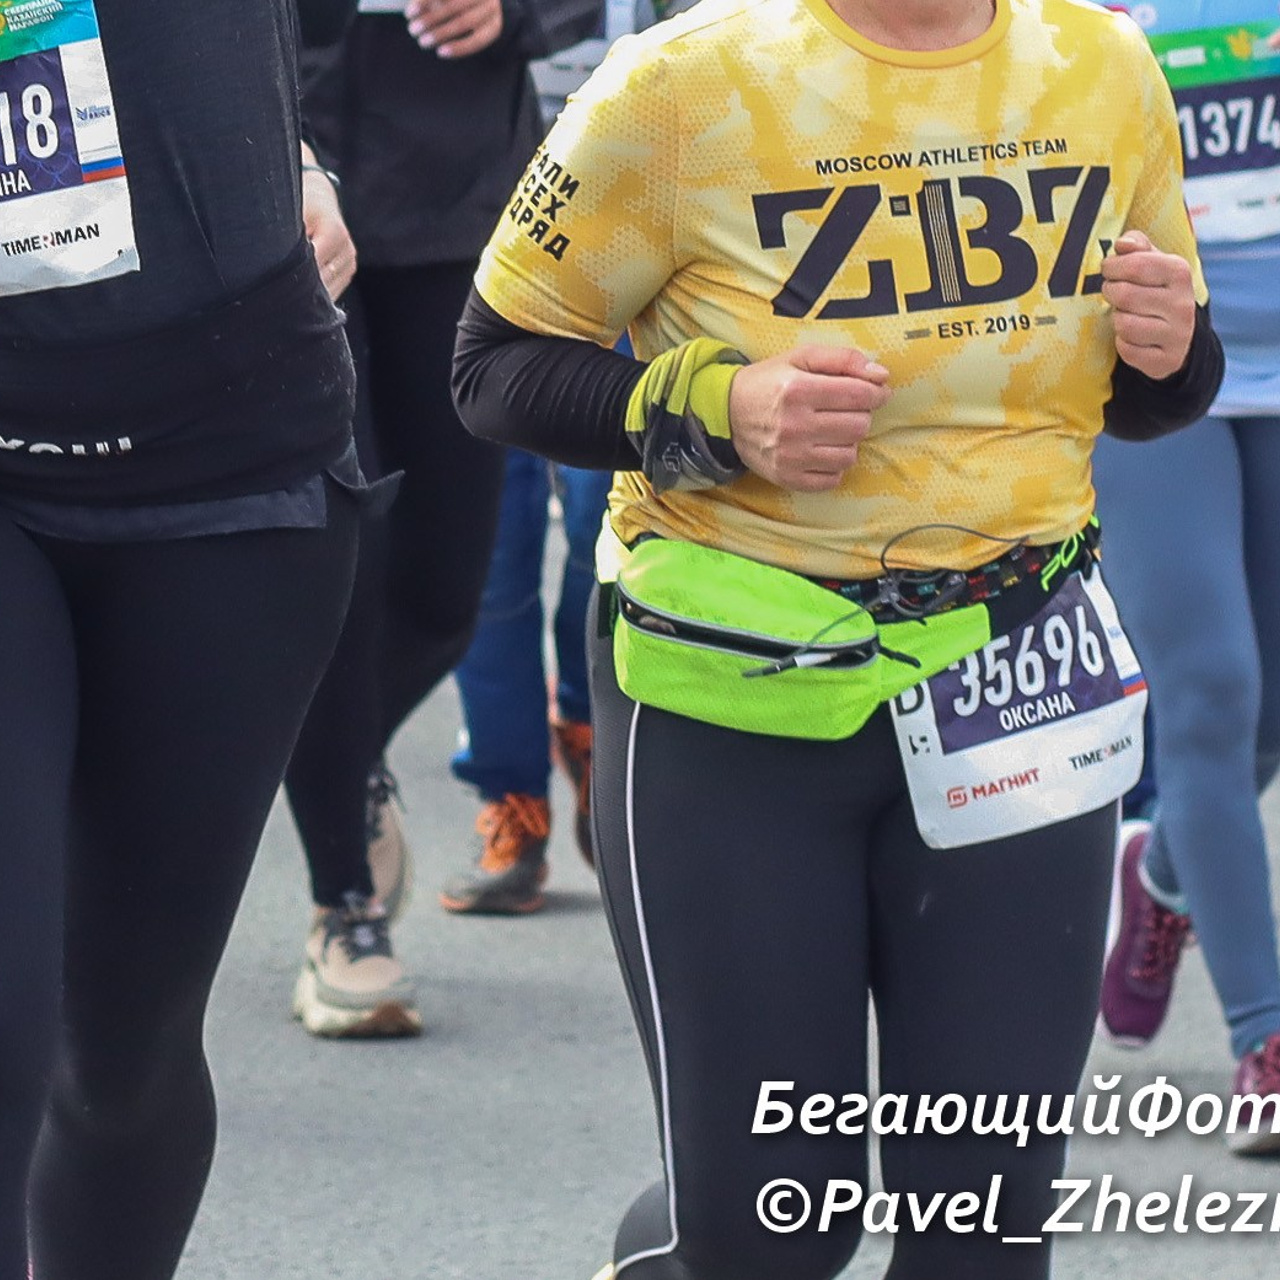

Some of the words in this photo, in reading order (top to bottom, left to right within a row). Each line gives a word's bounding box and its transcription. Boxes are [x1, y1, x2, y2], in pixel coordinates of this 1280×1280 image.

[815, 152, 912, 175] MOSCOW
[918, 141, 1018, 167] ATHLETICS
[1023, 137, 1067, 156] TEAM
[938, 321, 979, 339] EST.
[984, 314, 1031, 335] 2019
[948, 605, 1104, 717] 35696
[999, 691, 1076, 732] ОКСАНА
[971, 767, 1040, 800] МАГНИТ
